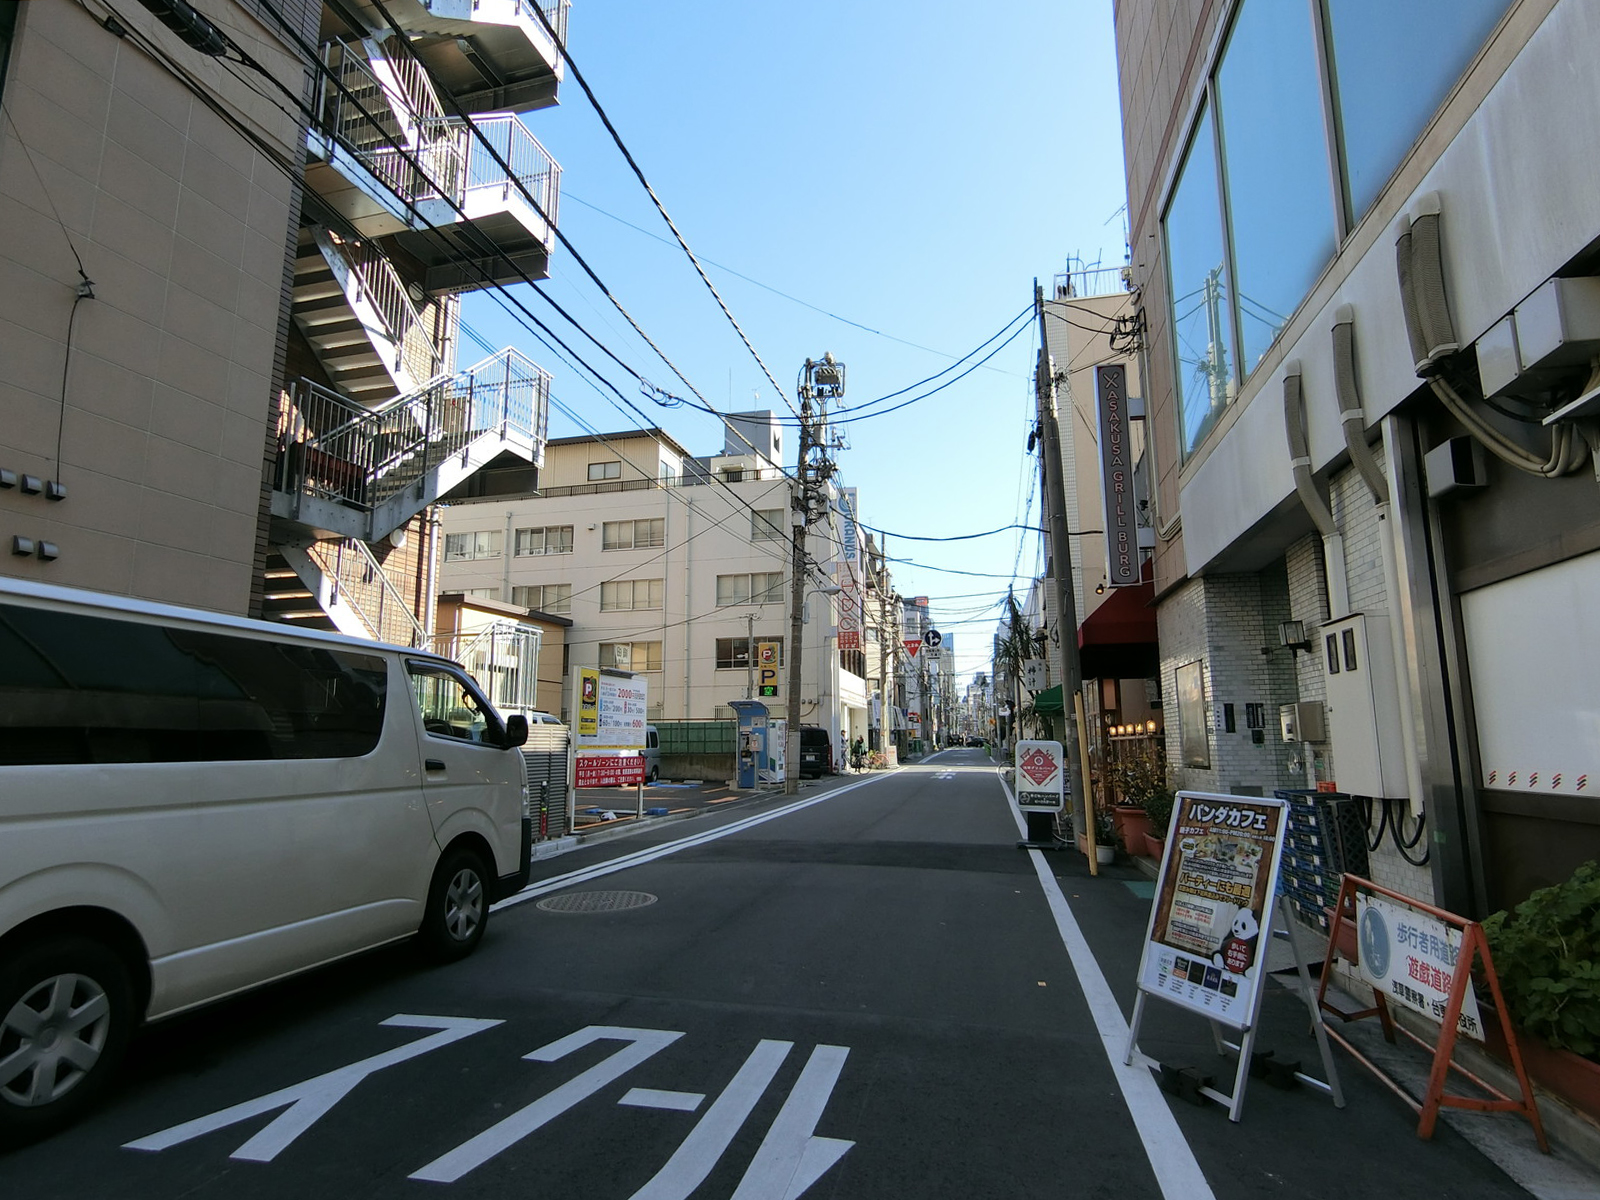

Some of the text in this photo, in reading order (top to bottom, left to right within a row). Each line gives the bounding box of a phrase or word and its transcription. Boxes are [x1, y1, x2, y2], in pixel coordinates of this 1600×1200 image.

[1107, 390, 1131, 577] ASAKUSA GRILL BURG
[762, 670, 775, 684] P
[1188, 803, 1267, 830] パンダカフェ
[1179, 872, 1252, 898] パーティーにも最適
[1397, 924, 1459, 966] 歩行者用道路
[119, 1012, 856, 1200] スクール
